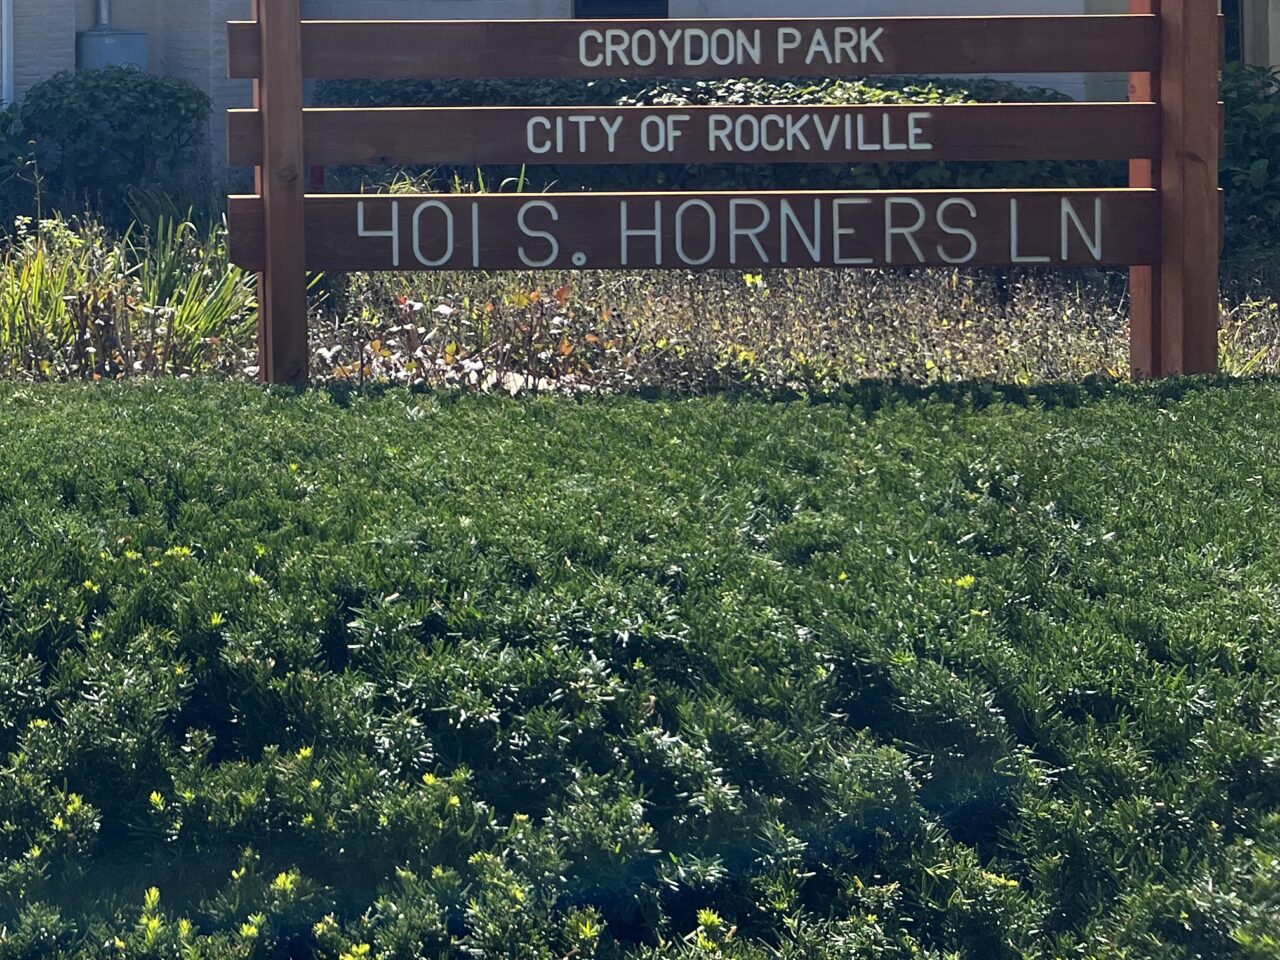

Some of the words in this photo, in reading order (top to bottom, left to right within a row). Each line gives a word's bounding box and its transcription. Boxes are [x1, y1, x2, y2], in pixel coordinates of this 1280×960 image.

[578, 27, 762, 68] CROYDON
[776, 25, 885, 66] PARK
[525, 114, 623, 155] CITY
[639, 113, 692, 154] OF
[707, 111, 933, 153] ROCKVILLE
[356, 200, 480, 269] 401
[517, 198, 588, 268] S.
[619, 197, 978, 267] HORNERS
[1009, 195, 1104, 264] LN
